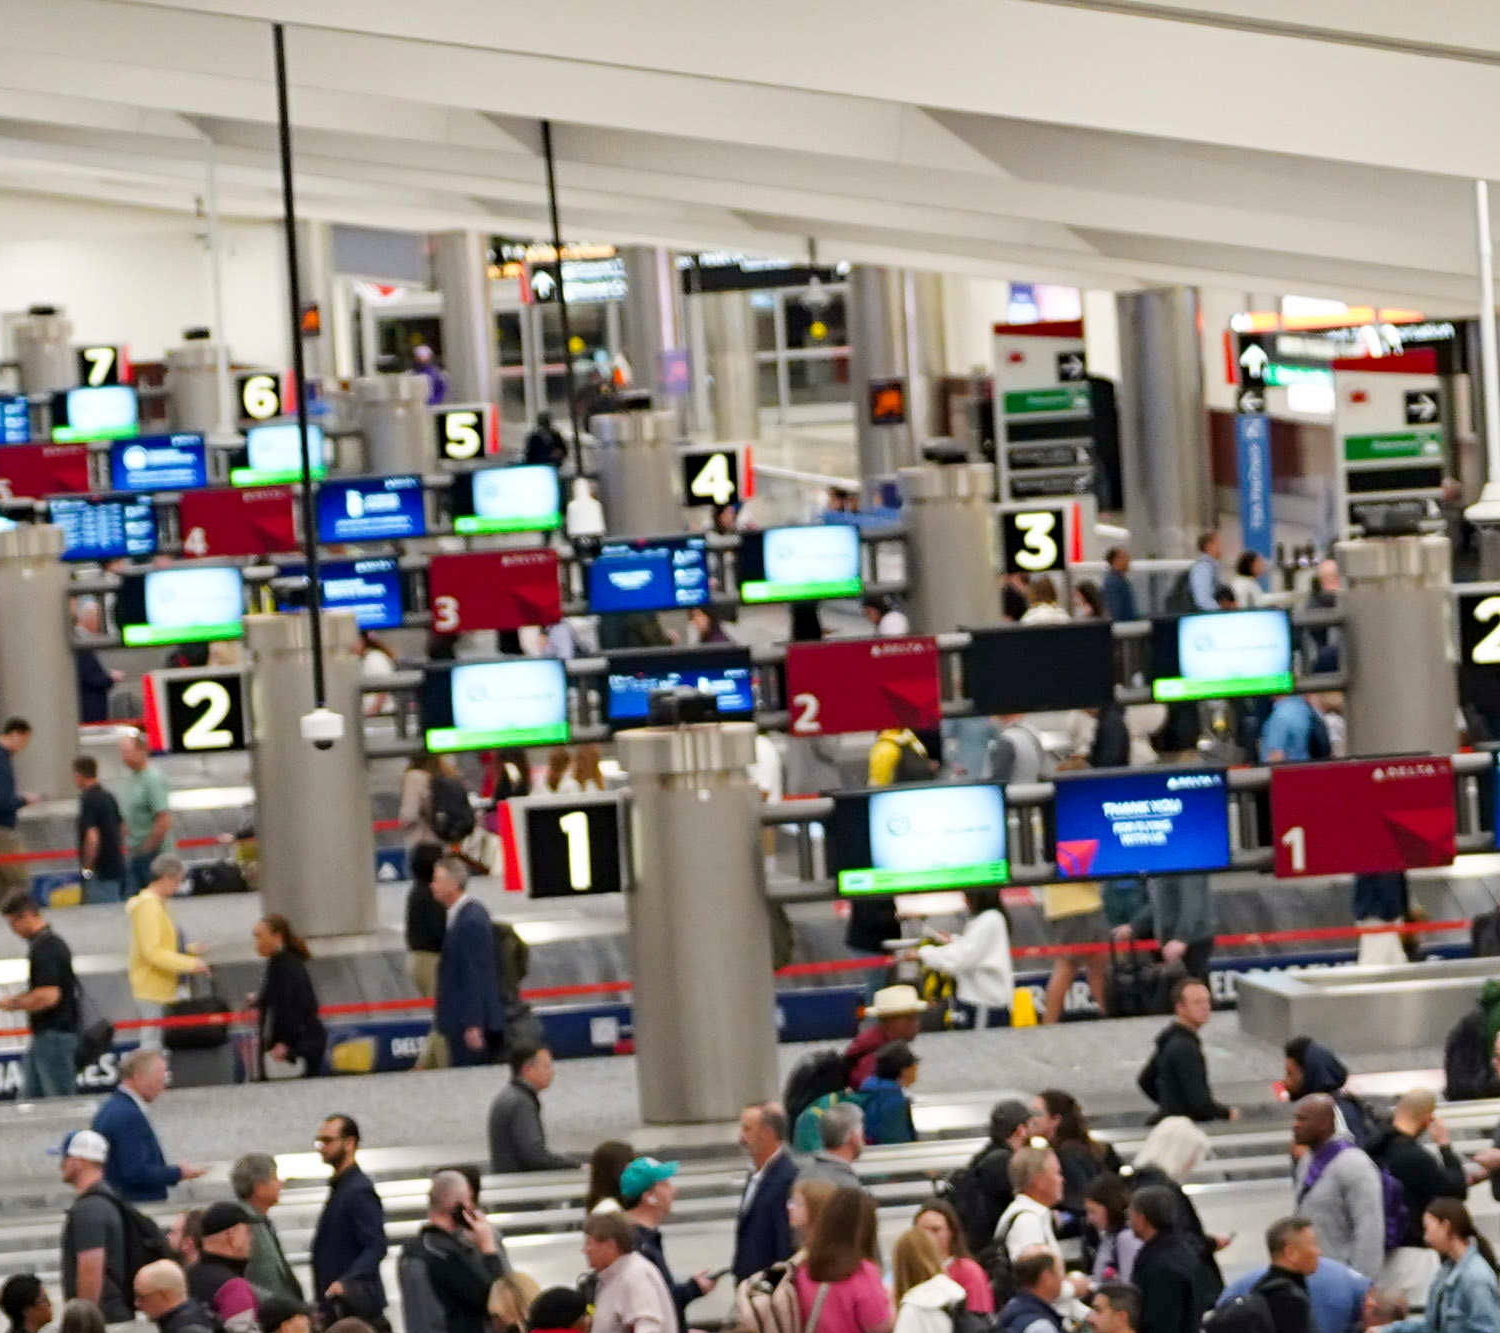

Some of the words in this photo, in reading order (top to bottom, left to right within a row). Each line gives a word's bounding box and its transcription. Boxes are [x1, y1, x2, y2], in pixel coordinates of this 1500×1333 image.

[88, 348, 117, 385] 7
[244, 375, 280, 419] 6
[445, 418, 481, 459] 5
[692, 453, 733, 503] 4
[184, 528, 207, 555] 4
[1014, 513, 1057, 571] 3
[434, 595, 460, 633] 3
[182, 679, 232, 750] 2
[793, 693, 821, 734] 2
[559, 811, 592, 890] 1
[1280, 826, 1306, 871] 1
